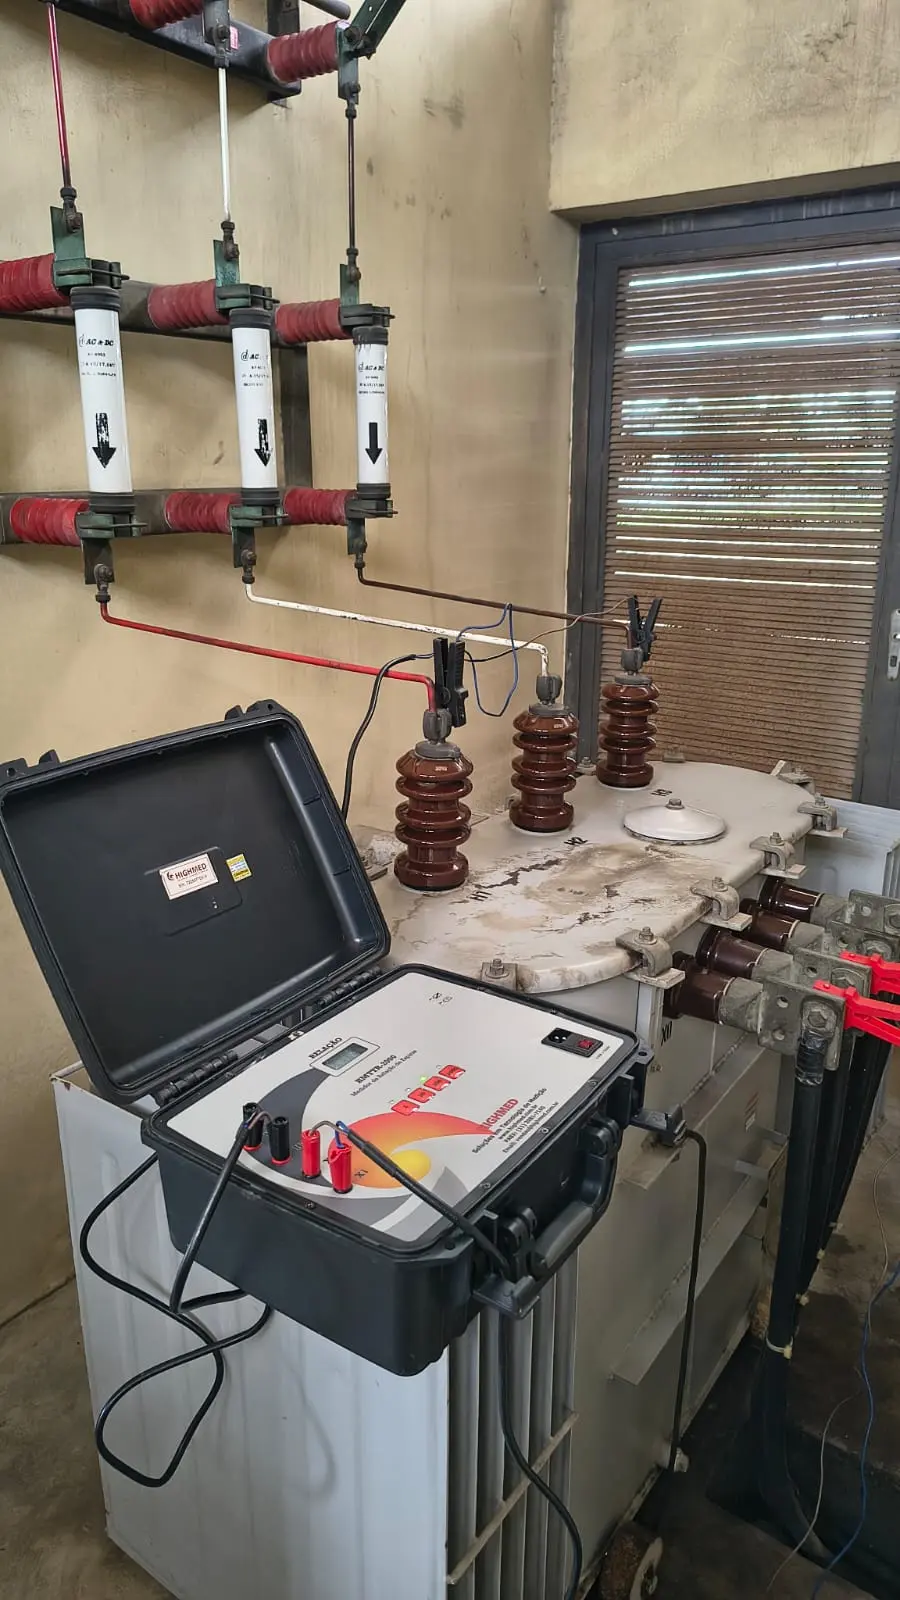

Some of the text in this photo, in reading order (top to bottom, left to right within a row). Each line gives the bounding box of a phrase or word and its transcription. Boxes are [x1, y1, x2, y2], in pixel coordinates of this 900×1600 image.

[564, 836, 588, 846] H2
[174, 862, 207, 880] HIGHMED
[469, 890, 492, 902] H1
